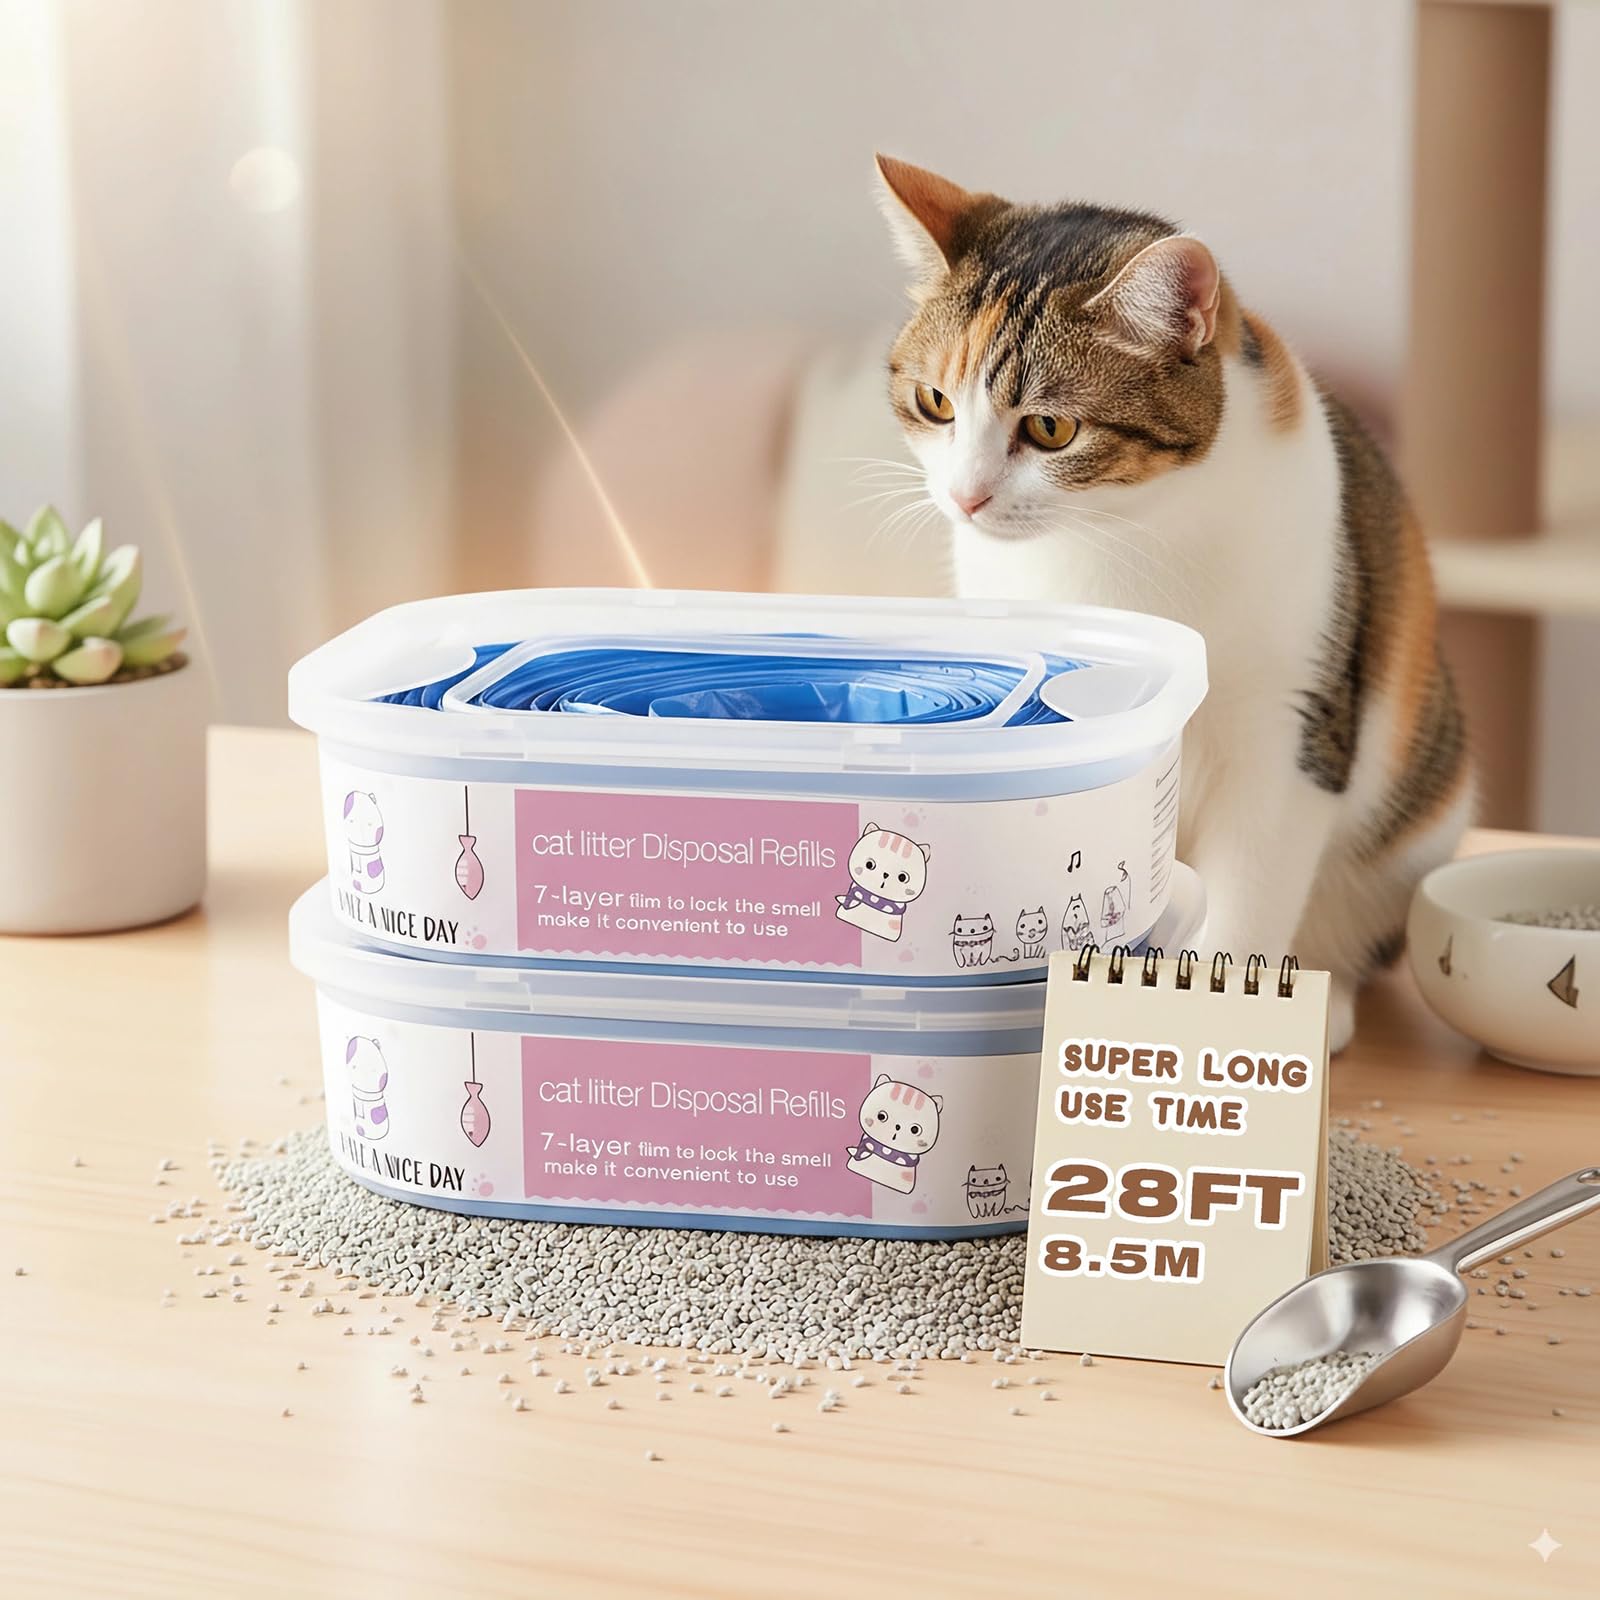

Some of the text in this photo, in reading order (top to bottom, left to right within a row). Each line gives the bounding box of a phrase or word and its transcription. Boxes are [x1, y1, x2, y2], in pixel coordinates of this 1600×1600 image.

[532, 830, 836, 869] cat litter Disposal Refills
[534, 884, 625, 911] 7-layer
[668, 895, 685, 911] to
[690, 895, 728, 912] lock
[735, 898, 765, 914] the
[771, 901, 821, 917] smell
[424, 916, 459, 944] DAY
[615, 917, 720, 932] convenient
[726, 919, 745, 935] to
[753, 922, 788, 937] use
[1063, 1043, 1308, 1088] SUPER LONG
[539, 1077, 846, 1119] cat litter Disposal Refills
[1060, 1090, 1243, 1131] USE TIME
[541, 1131, 631, 1159] 7-layer
[700, 1145, 738, 1161] lock
[781, 1152, 831, 1167] smell
[430, 1162, 465, 1191] DAY
[544, 1159, 799, 1187] make it convenient to use
[1047, 1163, 1300, 1225] 28FT
[1043, 1239, 1200, 1279] 8.5M
